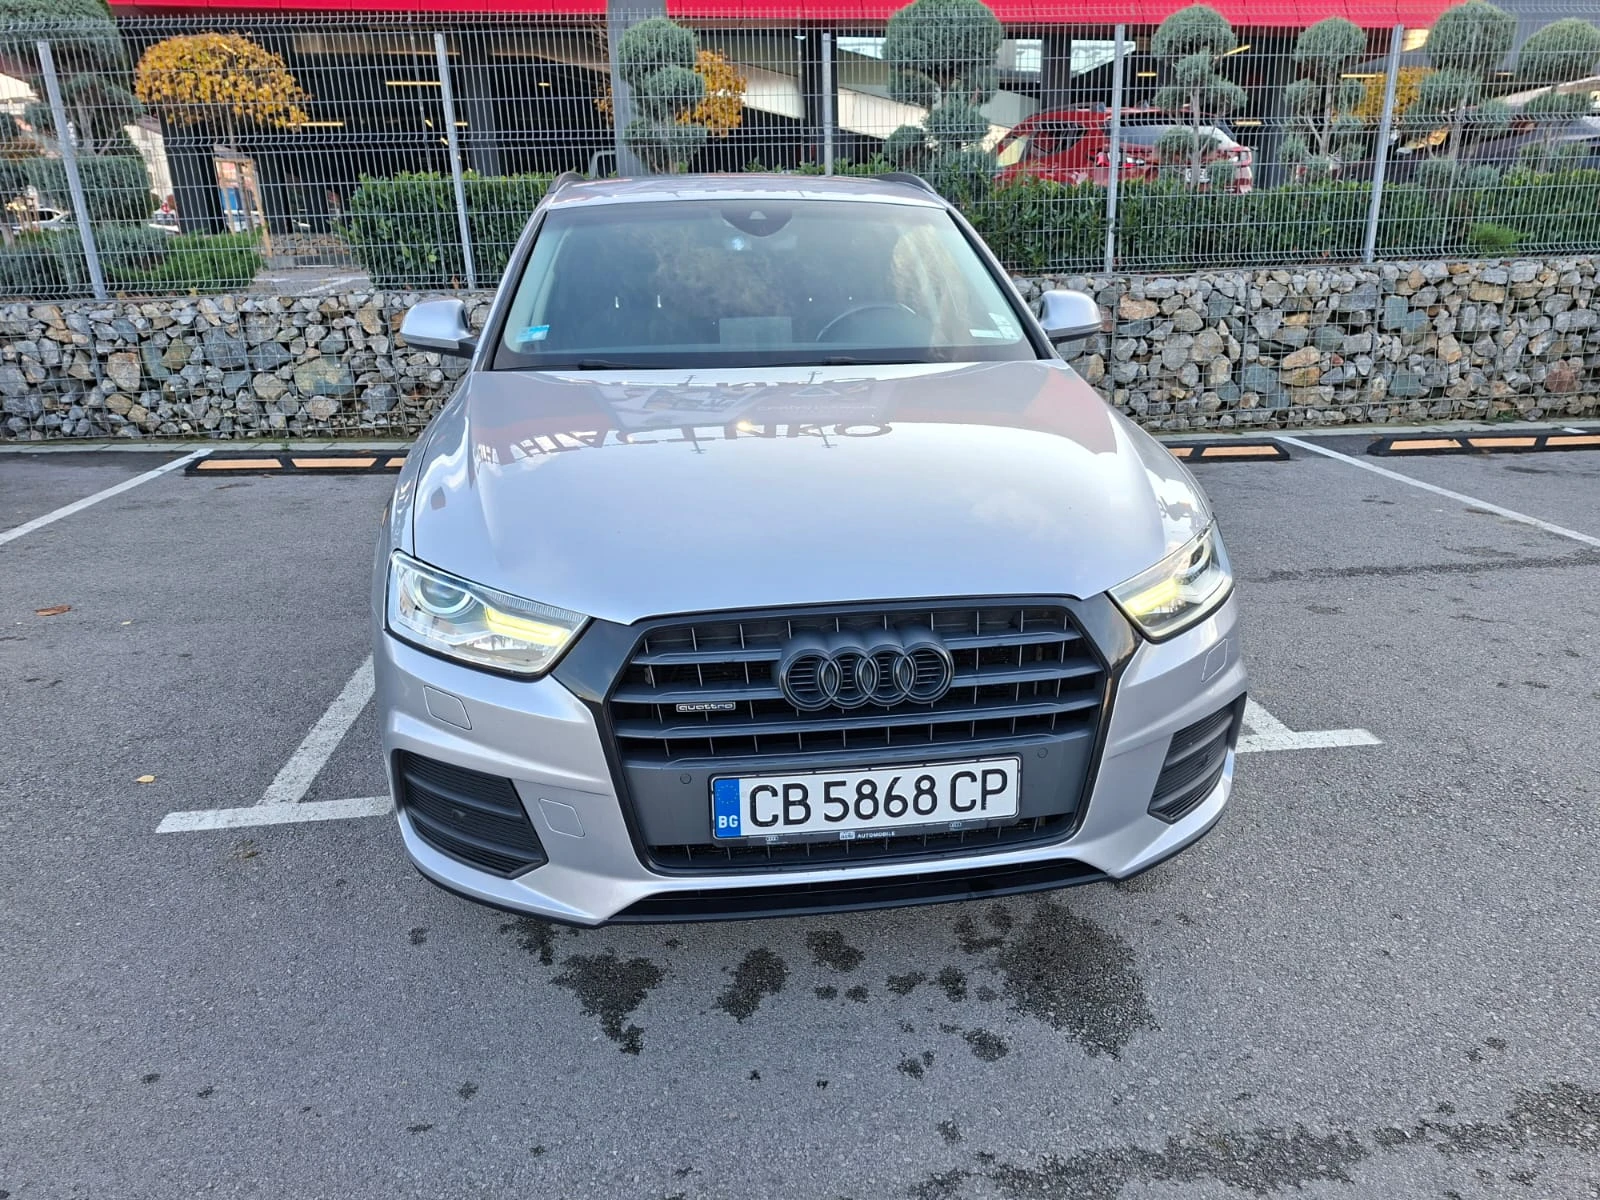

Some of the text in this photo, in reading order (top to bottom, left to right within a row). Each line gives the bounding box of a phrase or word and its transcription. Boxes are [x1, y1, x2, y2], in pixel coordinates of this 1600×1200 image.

[679, 703, 733, 711] quattro
[750, 768, 1008, 827] CB 5868 CP
[718, 815, 738, 828] BG
